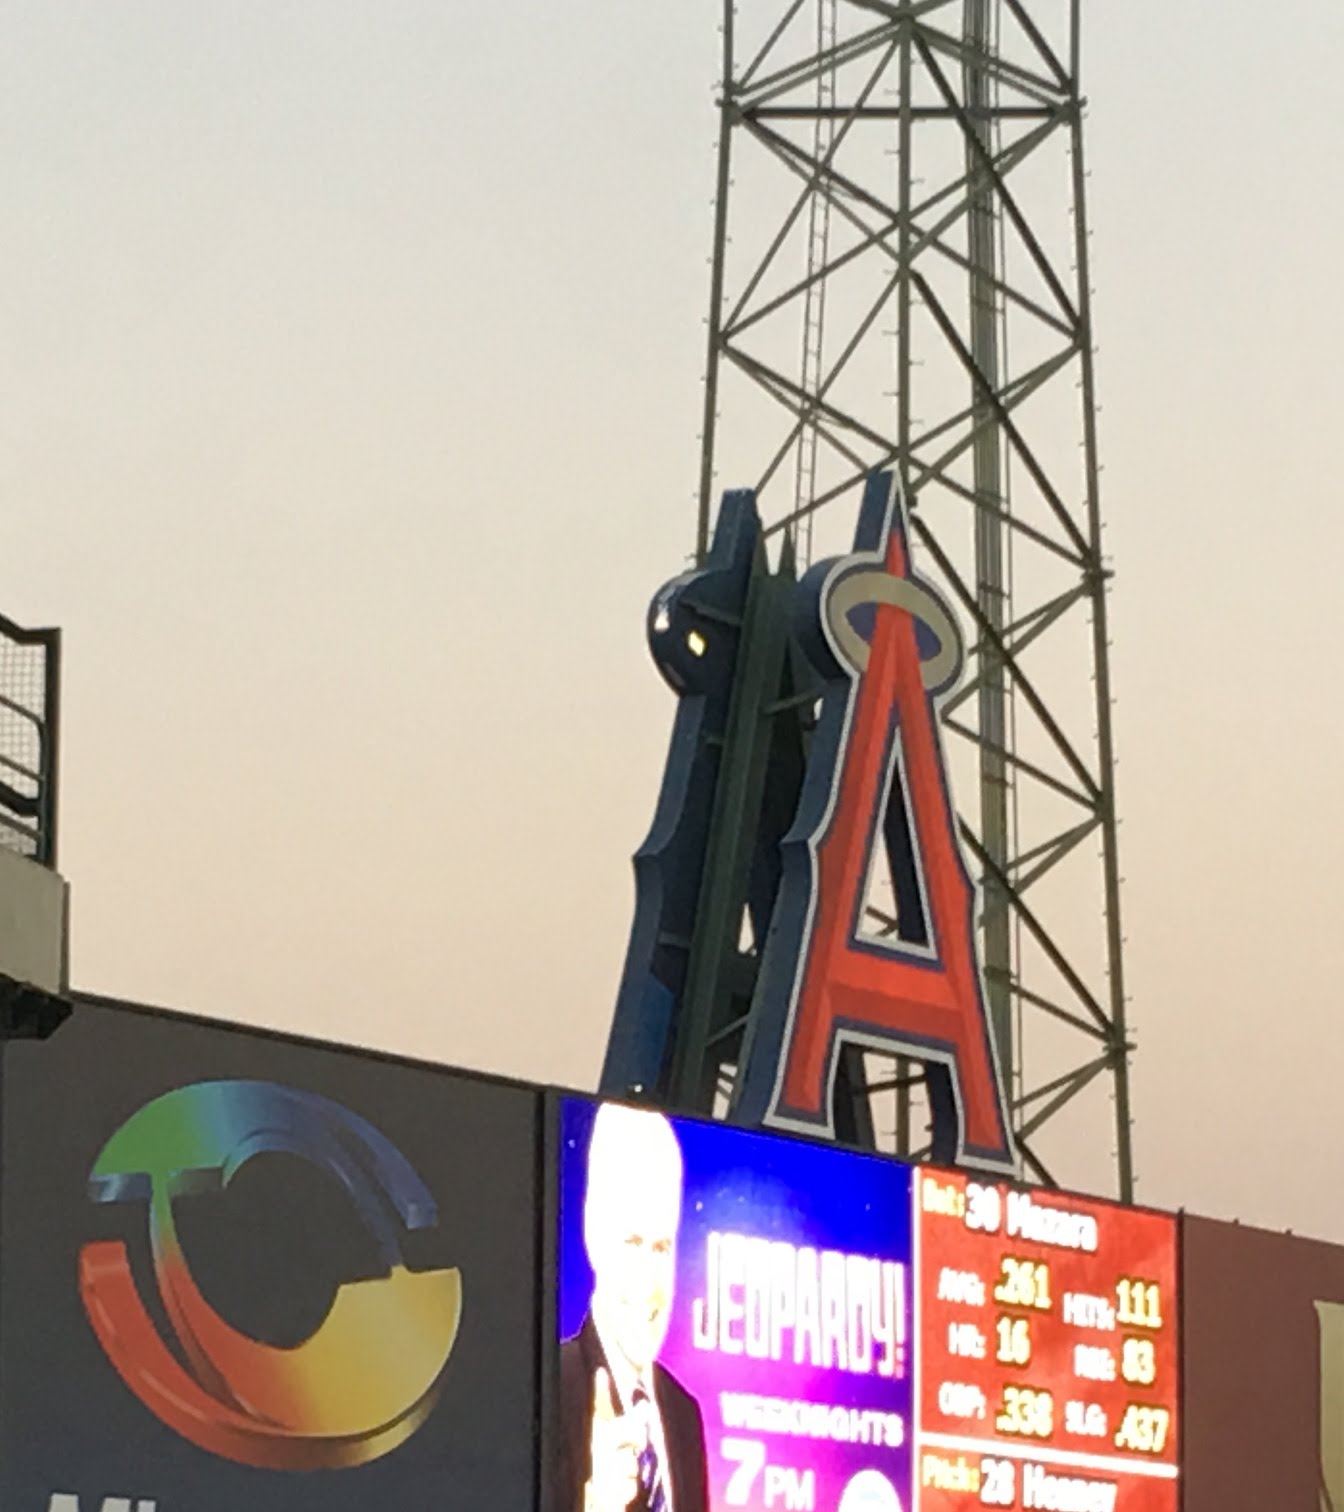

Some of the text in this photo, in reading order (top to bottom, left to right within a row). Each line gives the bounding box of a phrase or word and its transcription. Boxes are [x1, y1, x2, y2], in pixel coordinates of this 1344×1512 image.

[965, 1182, 1001, 1232] 30
[693, 1231, 905, 1379] JEOPARDY!
[1115, 1278, 1163, 1328] 111
[996, 1317, 1031, 1364] 16
[719, 1391, 904, 1447] WEEKNIGHTS
[720, 1437, 815, 1512] 7 PM
[980, 1458, 1015, 1505] 28
